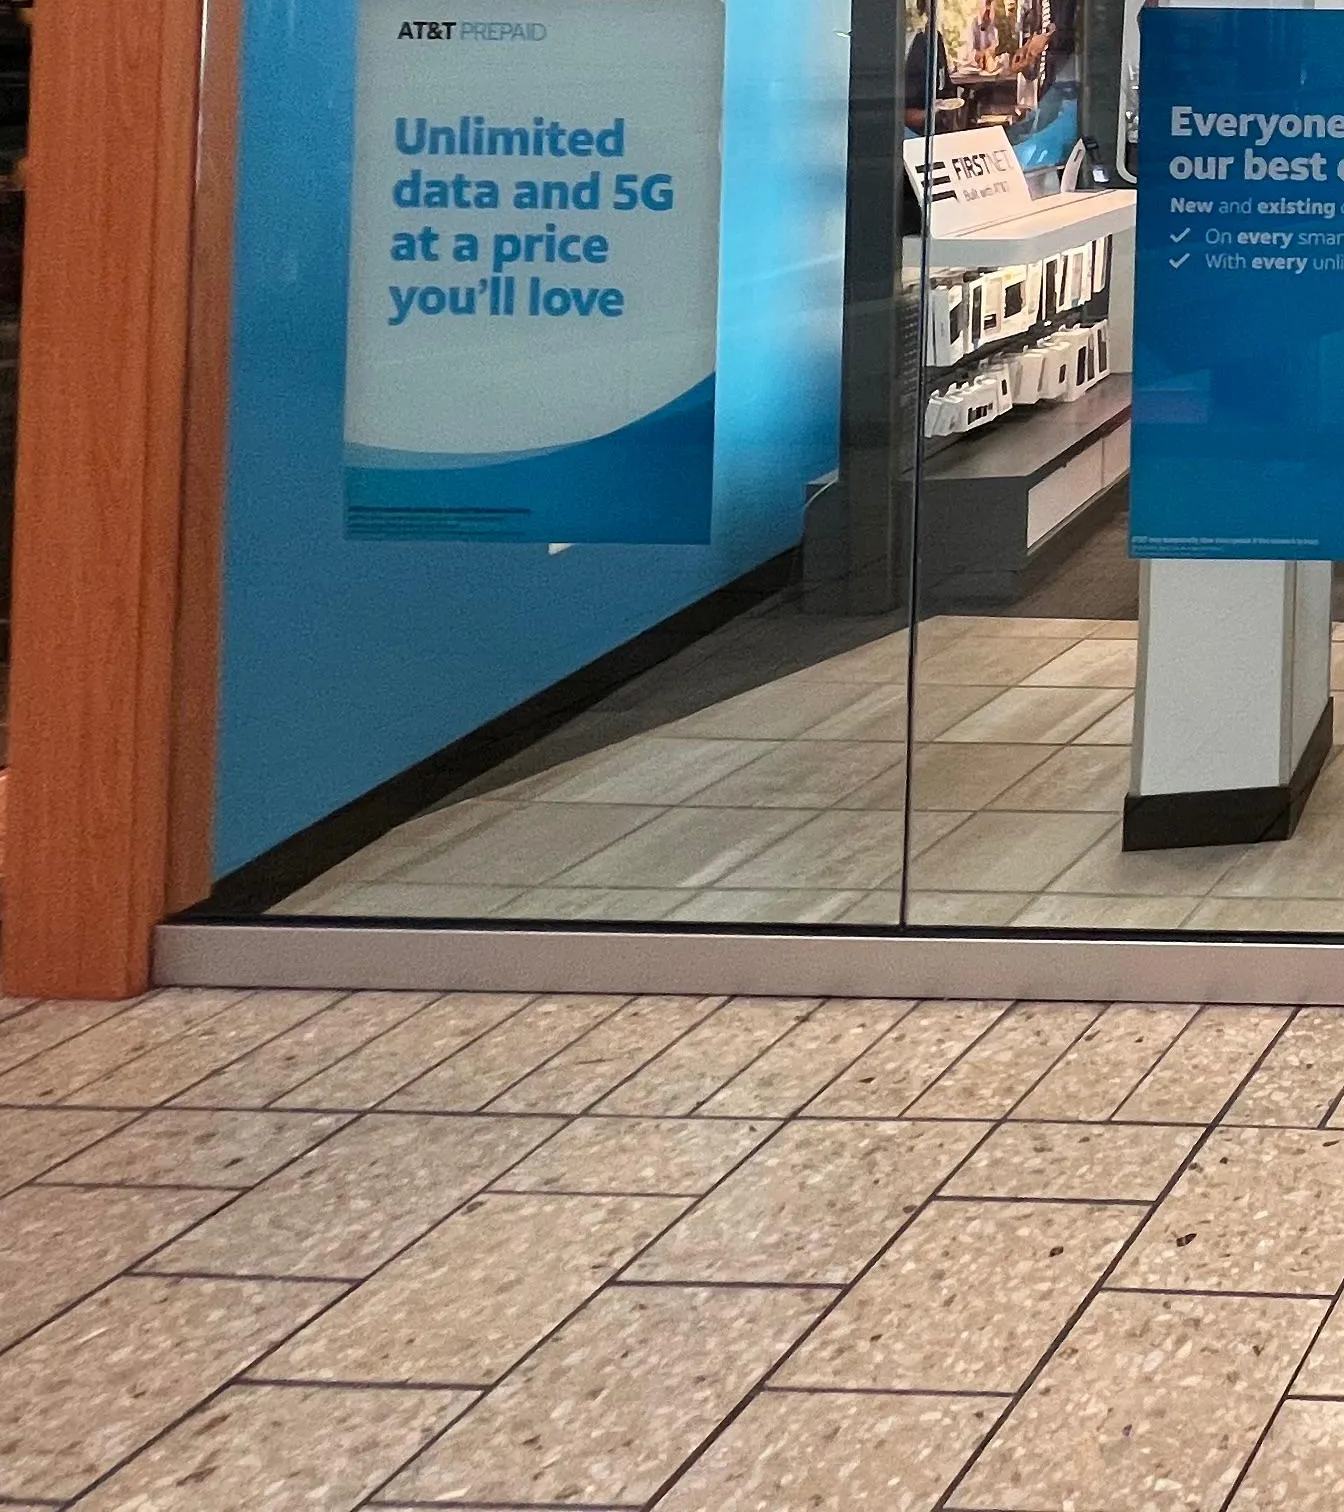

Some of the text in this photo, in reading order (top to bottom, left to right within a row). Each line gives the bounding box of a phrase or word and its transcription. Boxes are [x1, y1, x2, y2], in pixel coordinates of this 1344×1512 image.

[397, 22, 547, 41] AT&T PREPAID
[395, 117, 625, 157] Unlimited
[1169, 154, 1234, 180] our
[1244, 149, 1327, 181] best
[392, 169, 674, 211] data and 5G
[1170, 198, 1213, 213] New
[1219, 198, 1252, 214] and
[1257, 198, 1335, 219] existing
[390, 224, 609, 273] at a price
[1205, 228, 1232, 245] On
[1237, 231, 1293, 249] every
[1205, 253, 1246, 269] With
[1251, 257, 1308, 274] every
[388, 276, 624, 325] you'll love
